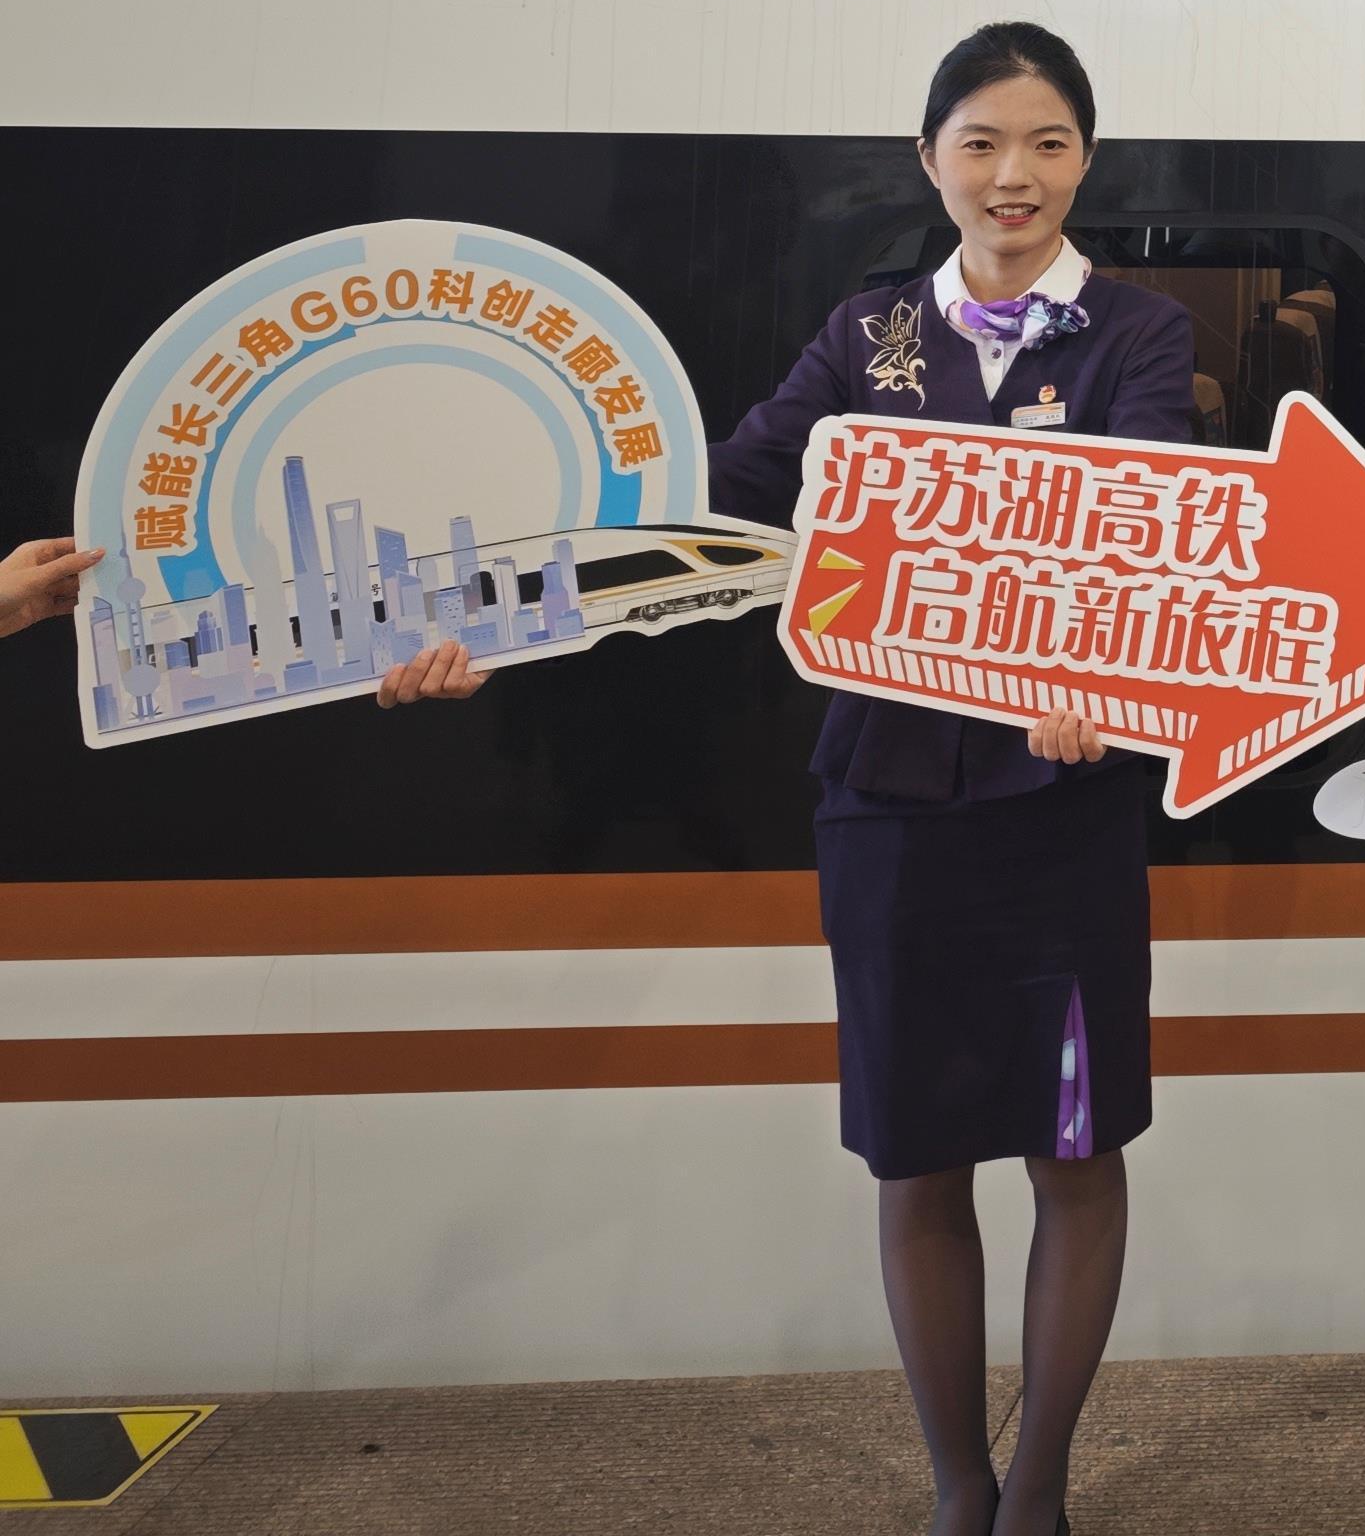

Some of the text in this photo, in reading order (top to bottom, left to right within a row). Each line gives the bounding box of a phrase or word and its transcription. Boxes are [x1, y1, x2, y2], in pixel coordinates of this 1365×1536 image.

[134, 268, 665, 552] 赋能长三角G60科创走廊发展
[816, 437, 1260, 582] 沪苏湖高铁
[884, 559, 1334, 687] 启航新旅程
